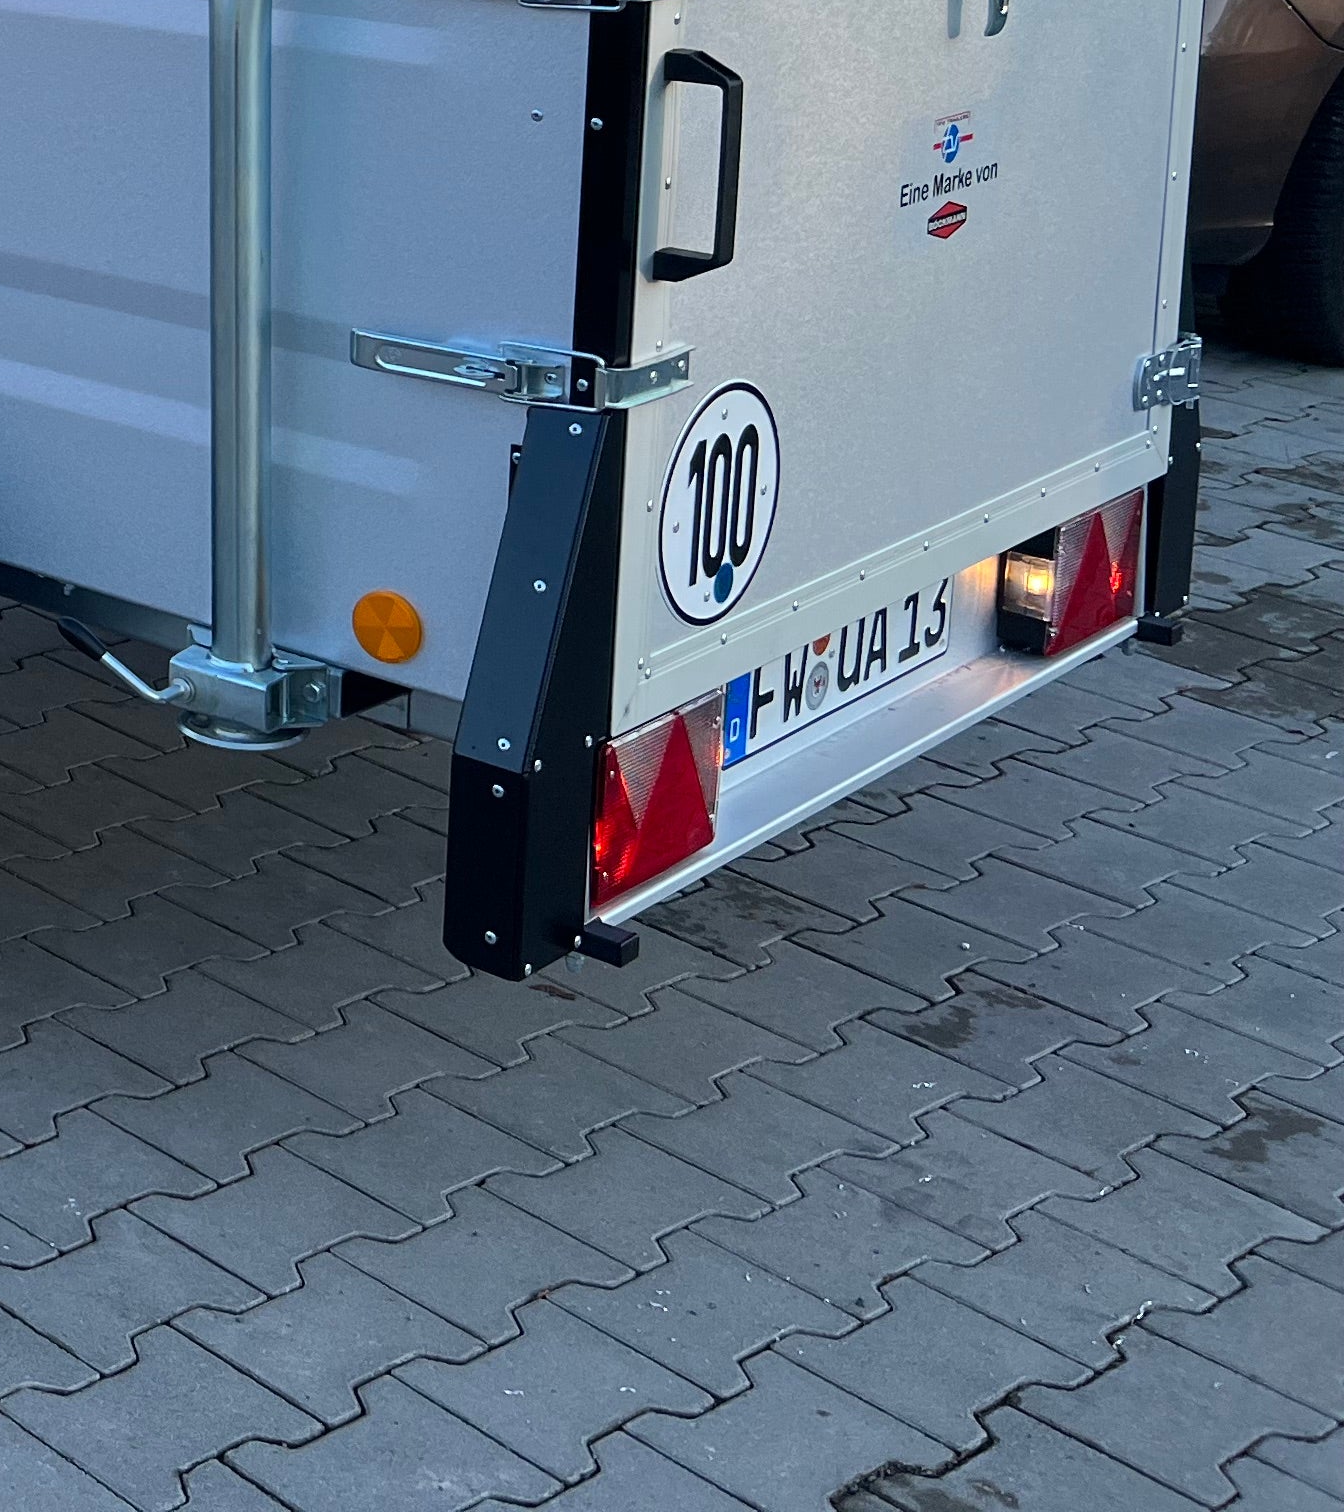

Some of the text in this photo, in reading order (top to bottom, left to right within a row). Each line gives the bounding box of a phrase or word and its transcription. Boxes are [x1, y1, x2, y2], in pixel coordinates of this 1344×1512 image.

[900, 162, 998, 207] Eine Marke von
[688, 423, 759, 587] 100
[837, 606, 888, 692] UA
[898, 577, 949, 663] 13
[729, 716, 739, 743] D
